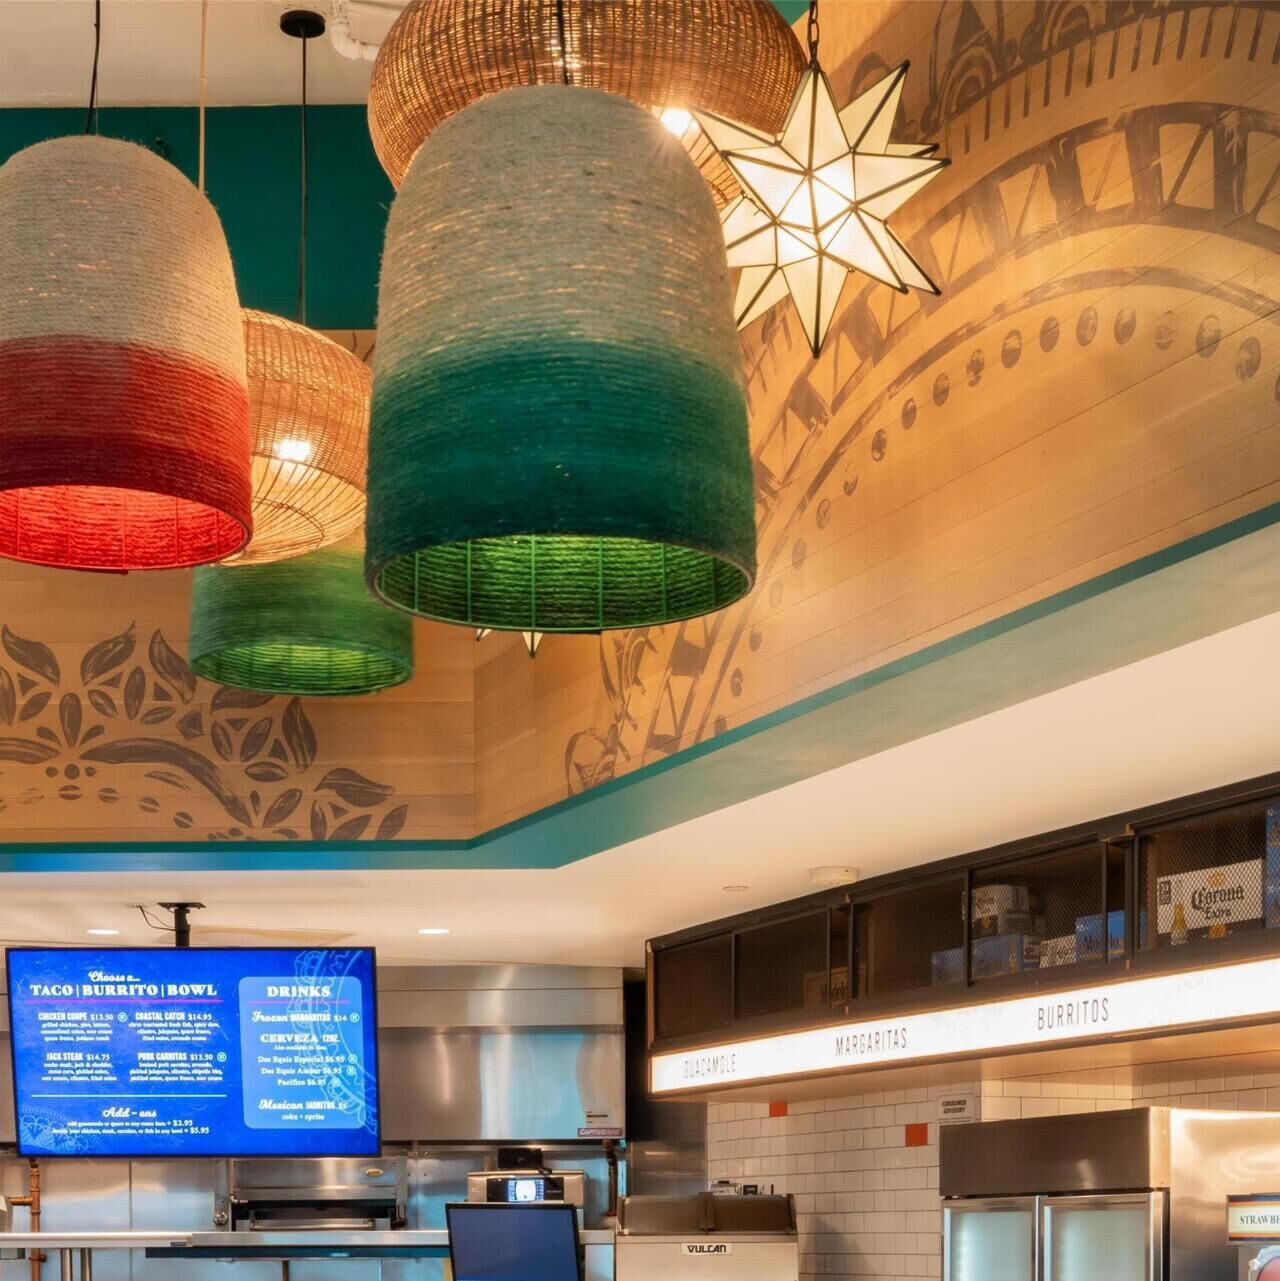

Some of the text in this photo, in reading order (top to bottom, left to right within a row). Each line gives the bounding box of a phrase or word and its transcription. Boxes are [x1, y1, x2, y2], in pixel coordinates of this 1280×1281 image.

[1191, 885, 1245, 911] Corona
[88, 970, 125, 982] Choose
[30, 984, 73, 996] TACO
[82, 984, 158, 996] BURRITO
[167, 984, 217, 996] BOWL
[267, 985, 331, 997] DRINKS
[1037, 996, 1111, 1031] BURRITOS
[260, 1034, 319, 1043] CERVEZA
[835, 1027, 908, 1057] MARGARITAS
[684, 1053, 737, 1079] GUACAMOLE
[687, 1243, 728, 1255] VULCAN
